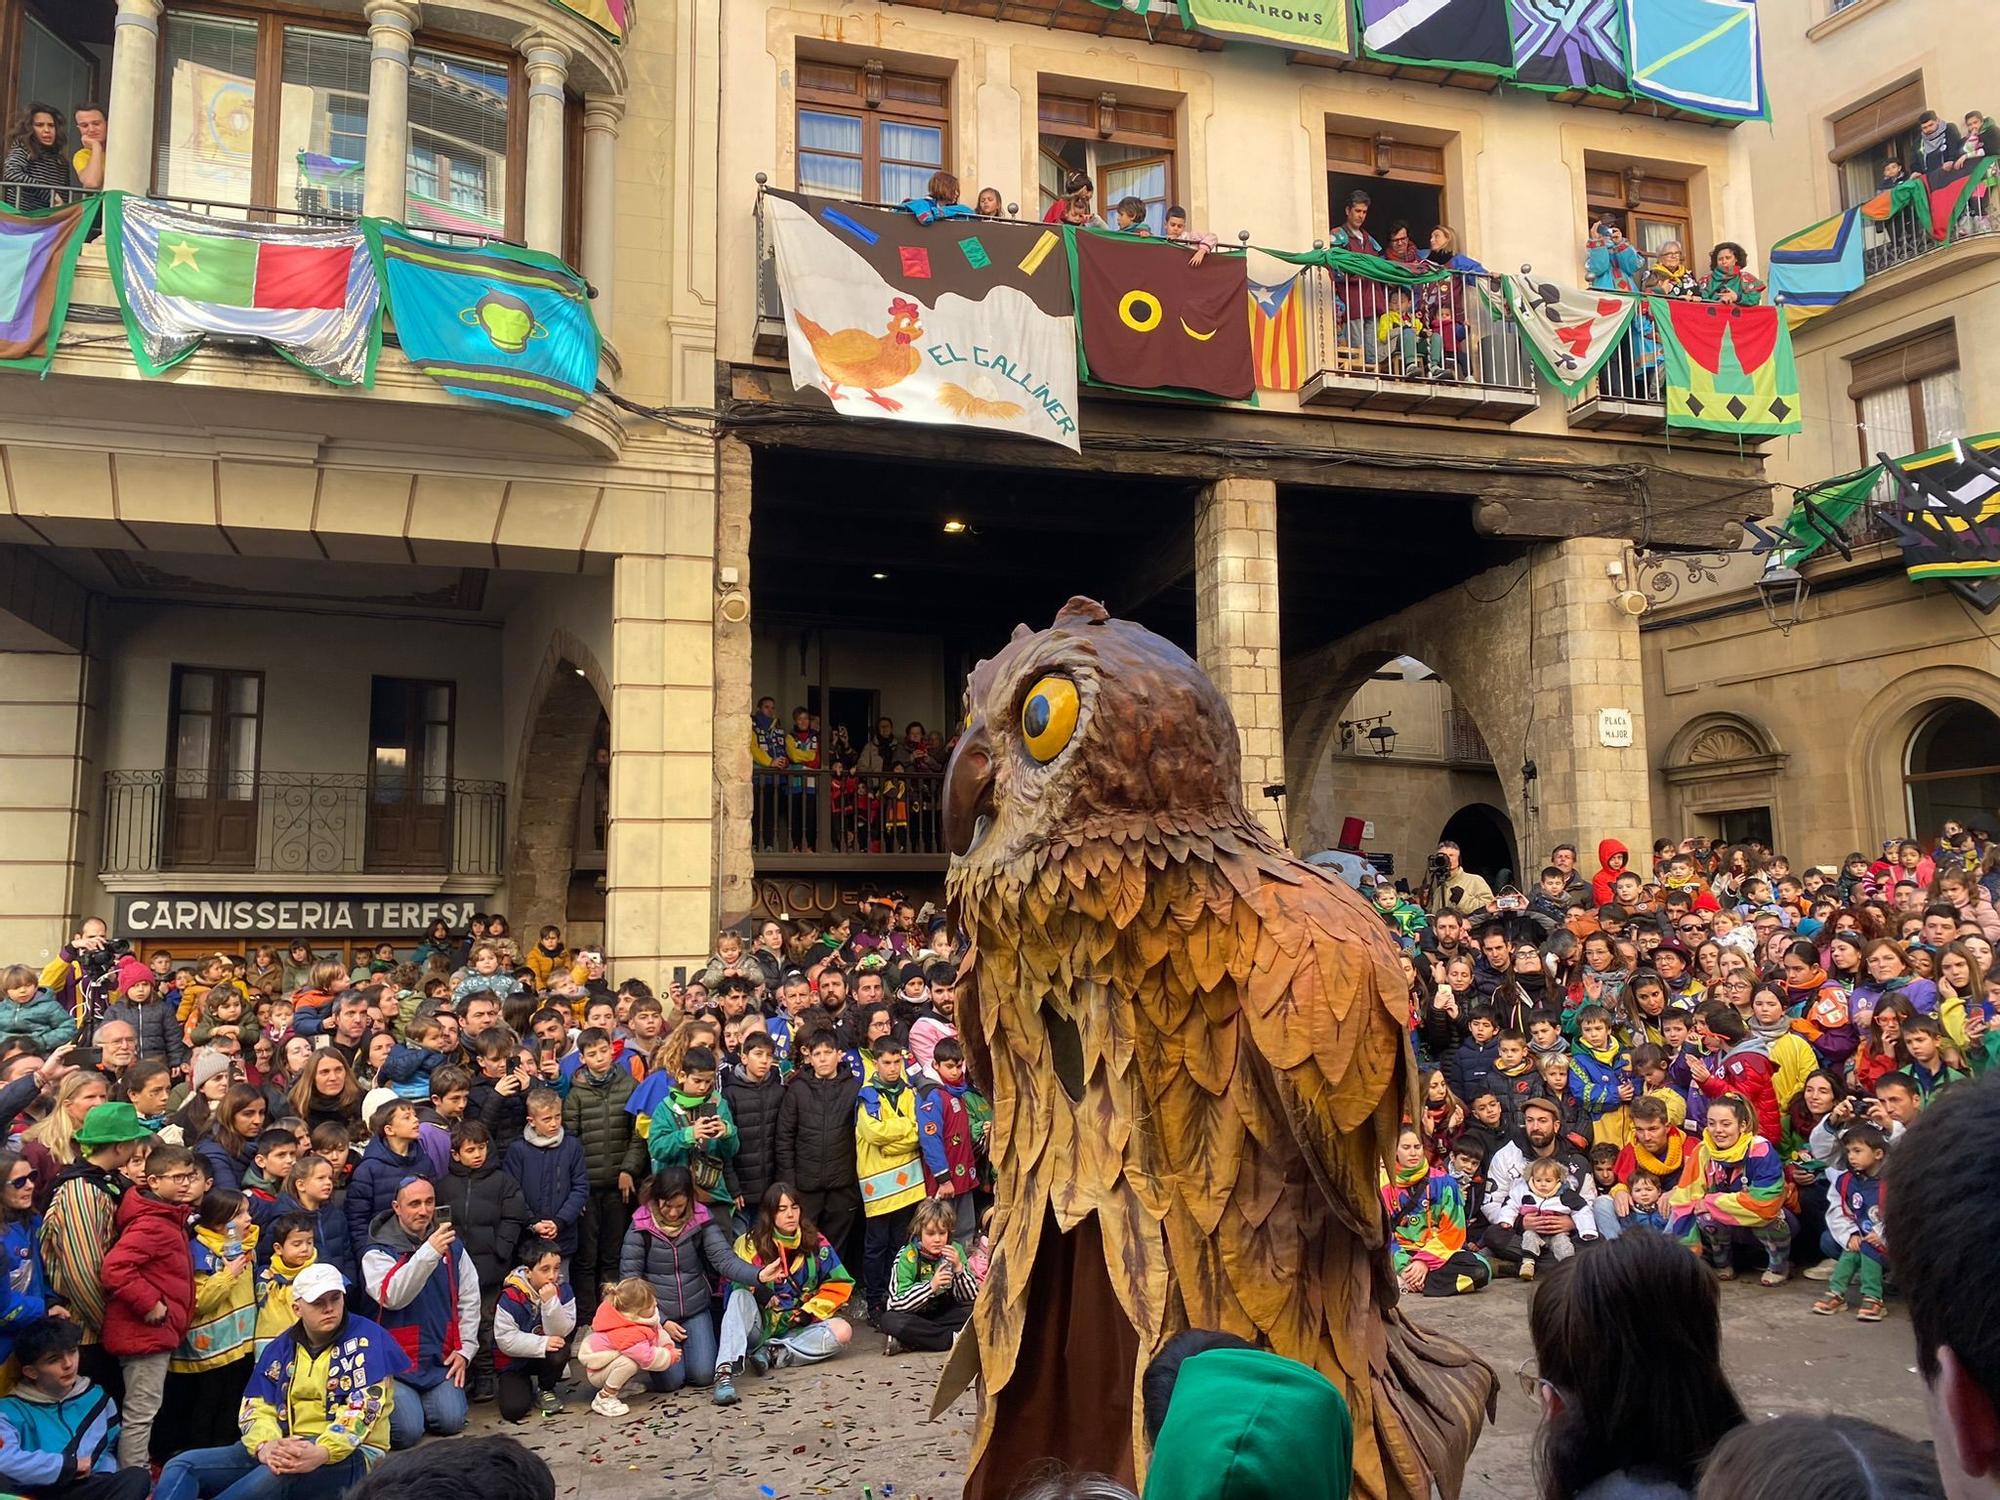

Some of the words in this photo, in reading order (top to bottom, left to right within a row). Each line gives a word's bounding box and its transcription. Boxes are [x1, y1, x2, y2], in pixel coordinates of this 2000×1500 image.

[1217, 0, 1323, 26] AIRONS
[927, 342, 968, 367] EL
[1605, 730, 1628, 738] MAJOR
[127, 900, 354, 930] CARNISSERIA
[362, 902, 476, 929] TERESA
